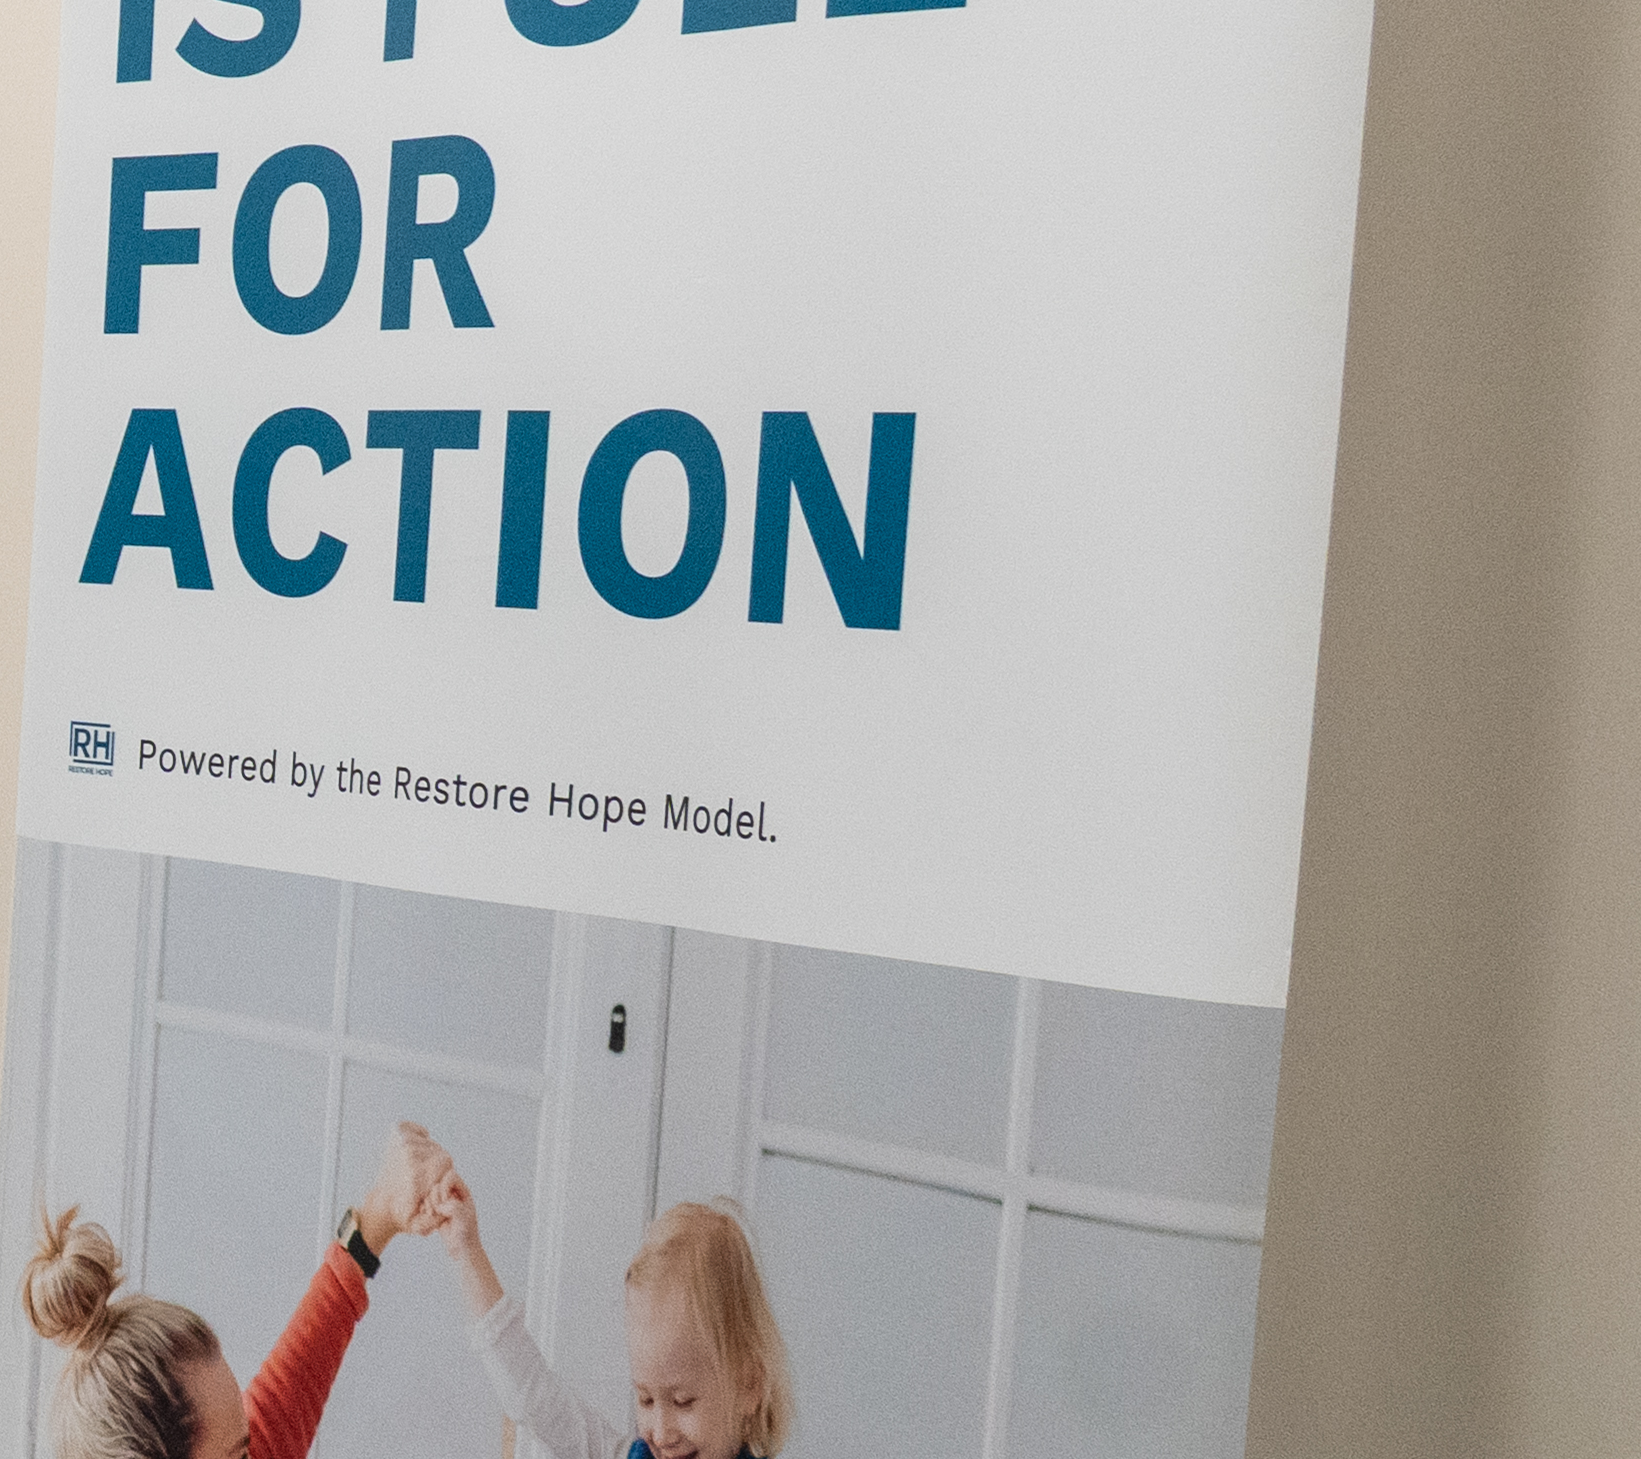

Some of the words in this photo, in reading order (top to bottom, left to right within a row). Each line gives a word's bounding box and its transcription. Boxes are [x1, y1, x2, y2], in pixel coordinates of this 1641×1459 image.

[103, 134, 496, 334] FOR
[77, 407, 917, 632] ACTION
[73, 728, 110, 760] RH
[138, 738, 278, 786] Powered
[290, 751, 325, 798] by
[336, 759, 382, 796] the
[394, 767, 530, 814] Restore
[548, 782, 647, 832] Hope
[662, 794, 778, 843] Model.
